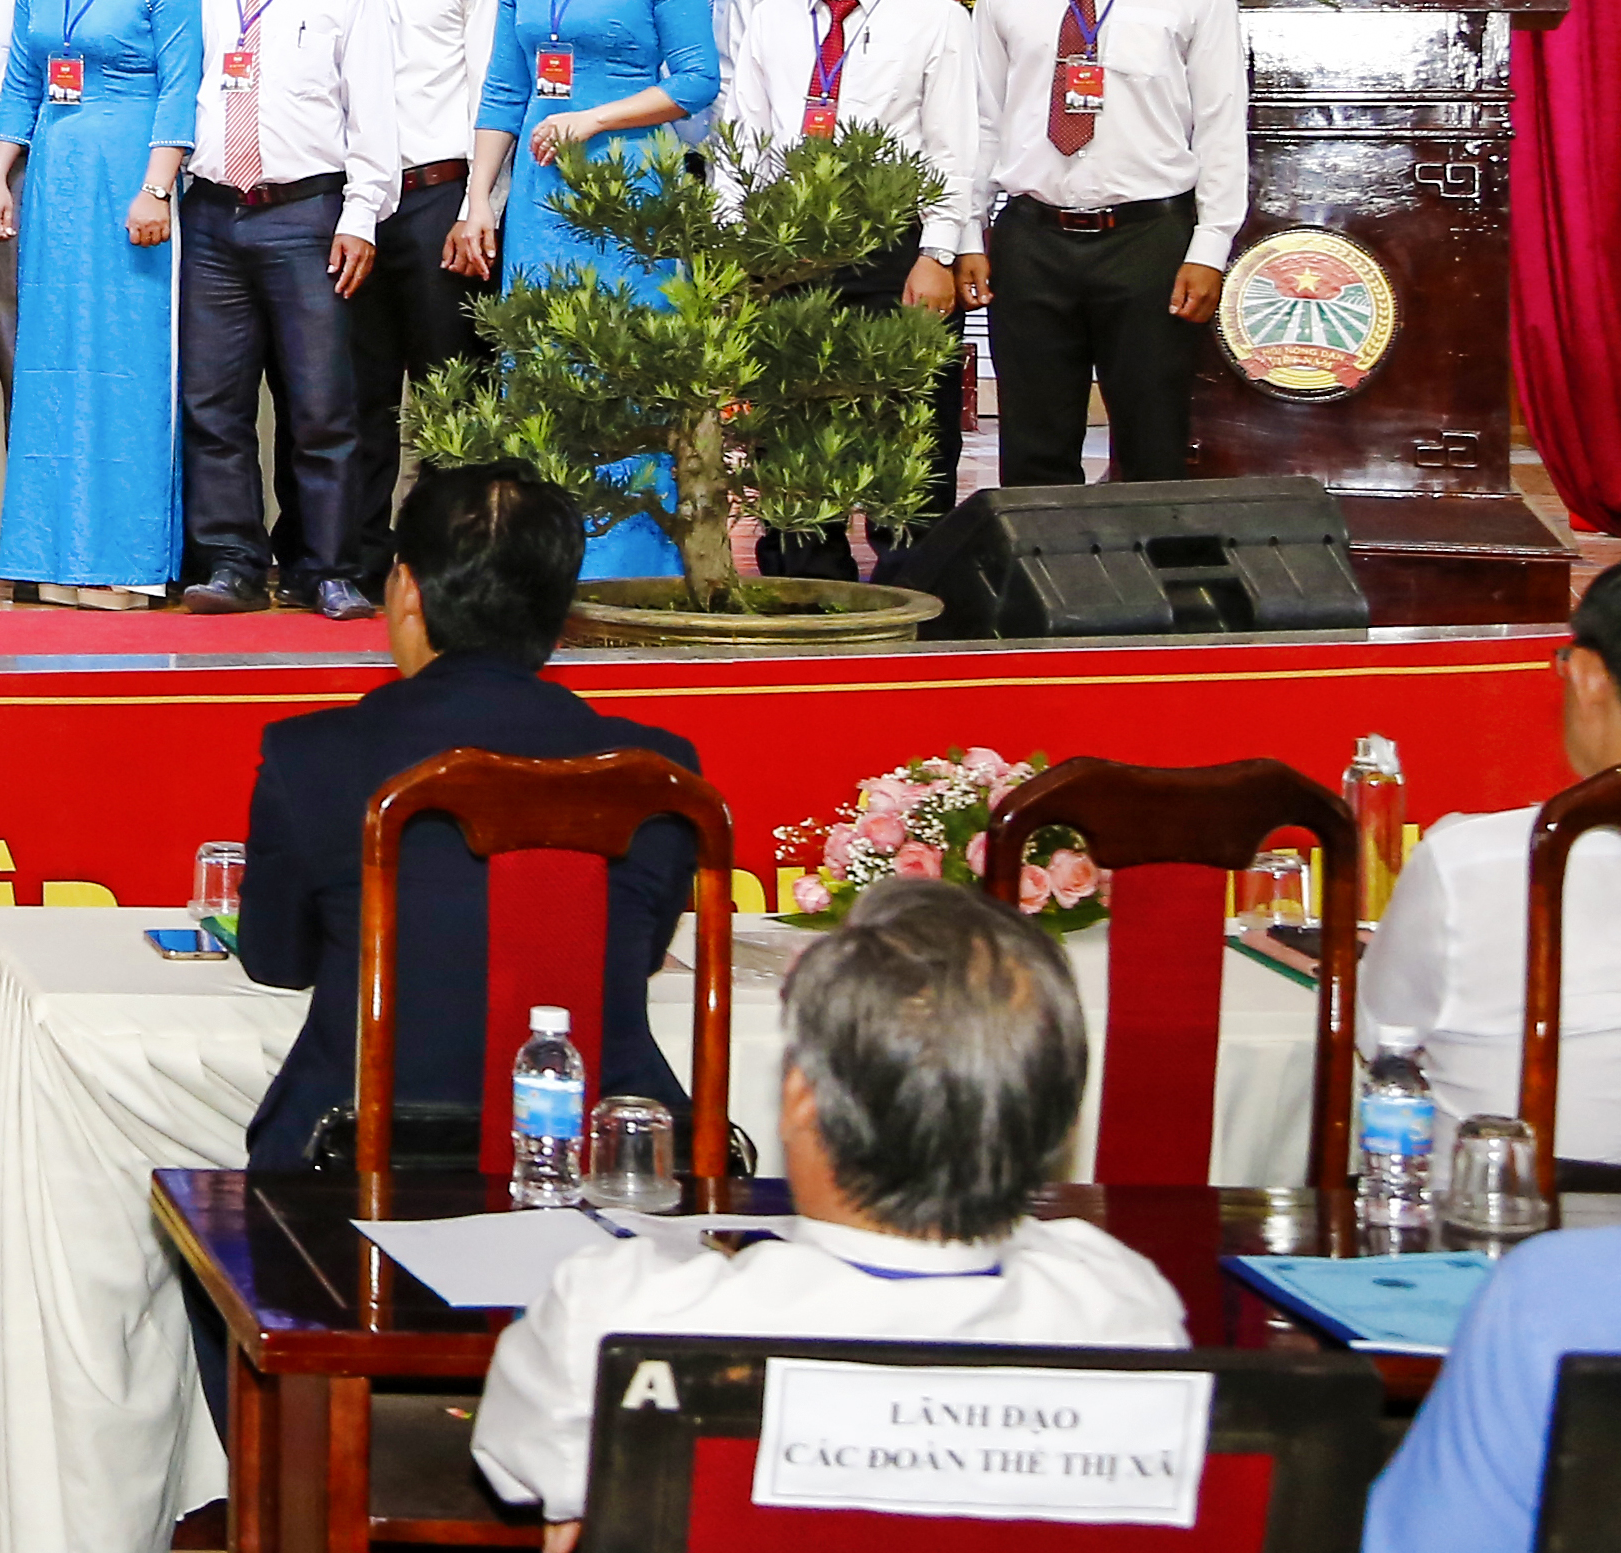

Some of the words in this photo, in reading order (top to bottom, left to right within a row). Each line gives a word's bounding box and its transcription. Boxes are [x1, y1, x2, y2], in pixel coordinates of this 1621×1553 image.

[621, 1360, 680, 1410] A
[890, 1395, 989, 1428] LÃNH
[1001, 1404, 1081, 1434] ĐẠO
[783, 1441, 864, 1468] CÁC
